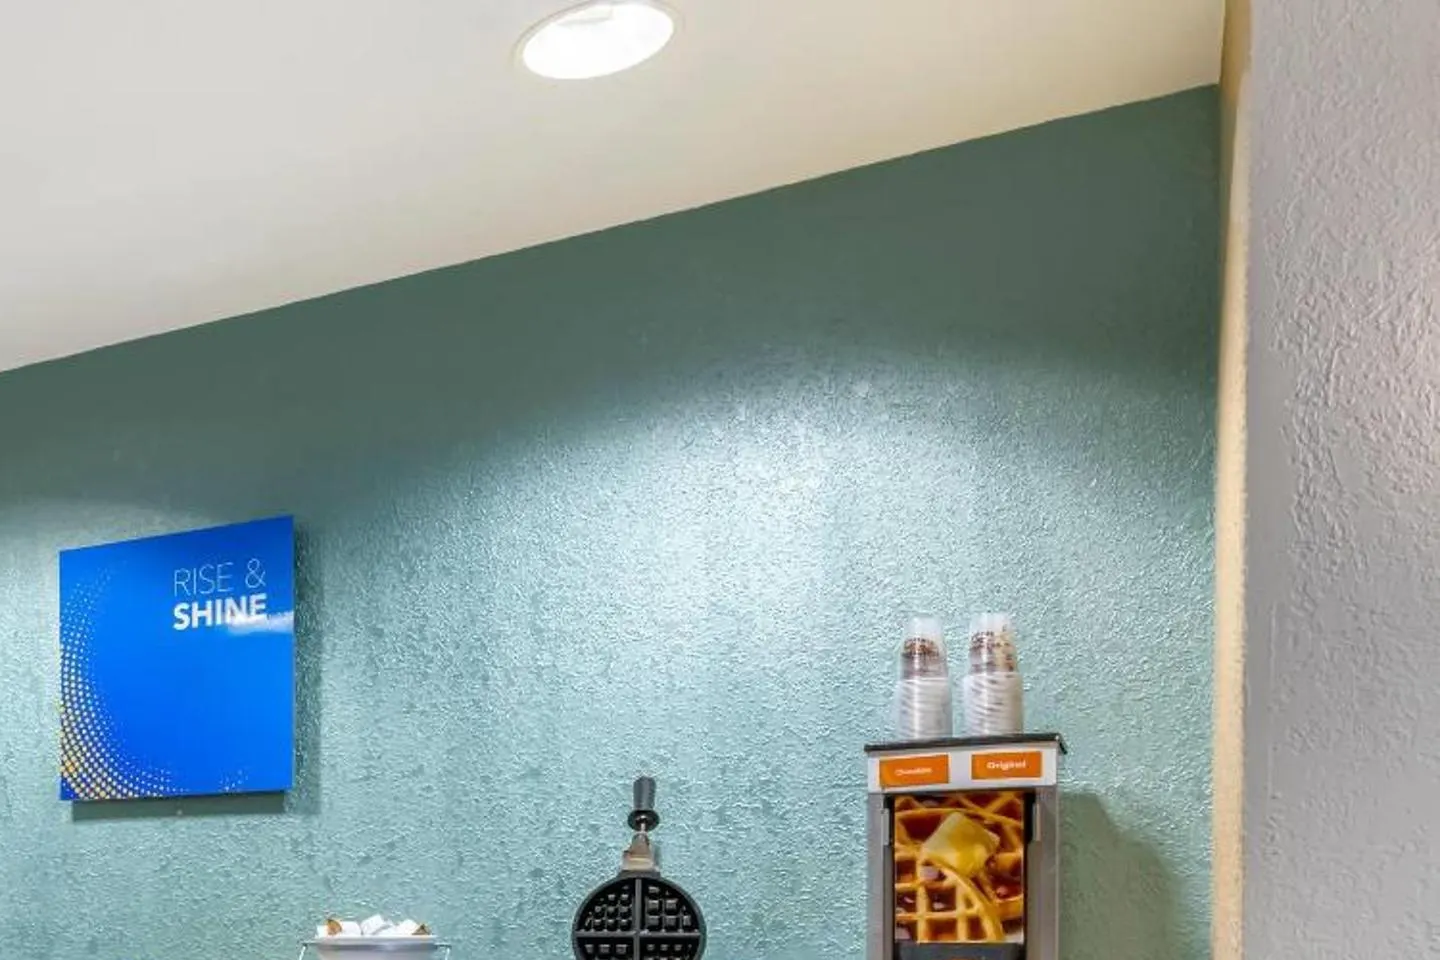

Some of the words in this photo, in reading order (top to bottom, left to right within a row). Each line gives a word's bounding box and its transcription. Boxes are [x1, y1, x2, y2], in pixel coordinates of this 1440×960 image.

[173, 561, 235, 598] RISE
[245, 557, 266, 589] &
[172, 592, 267, 631] SHINE
